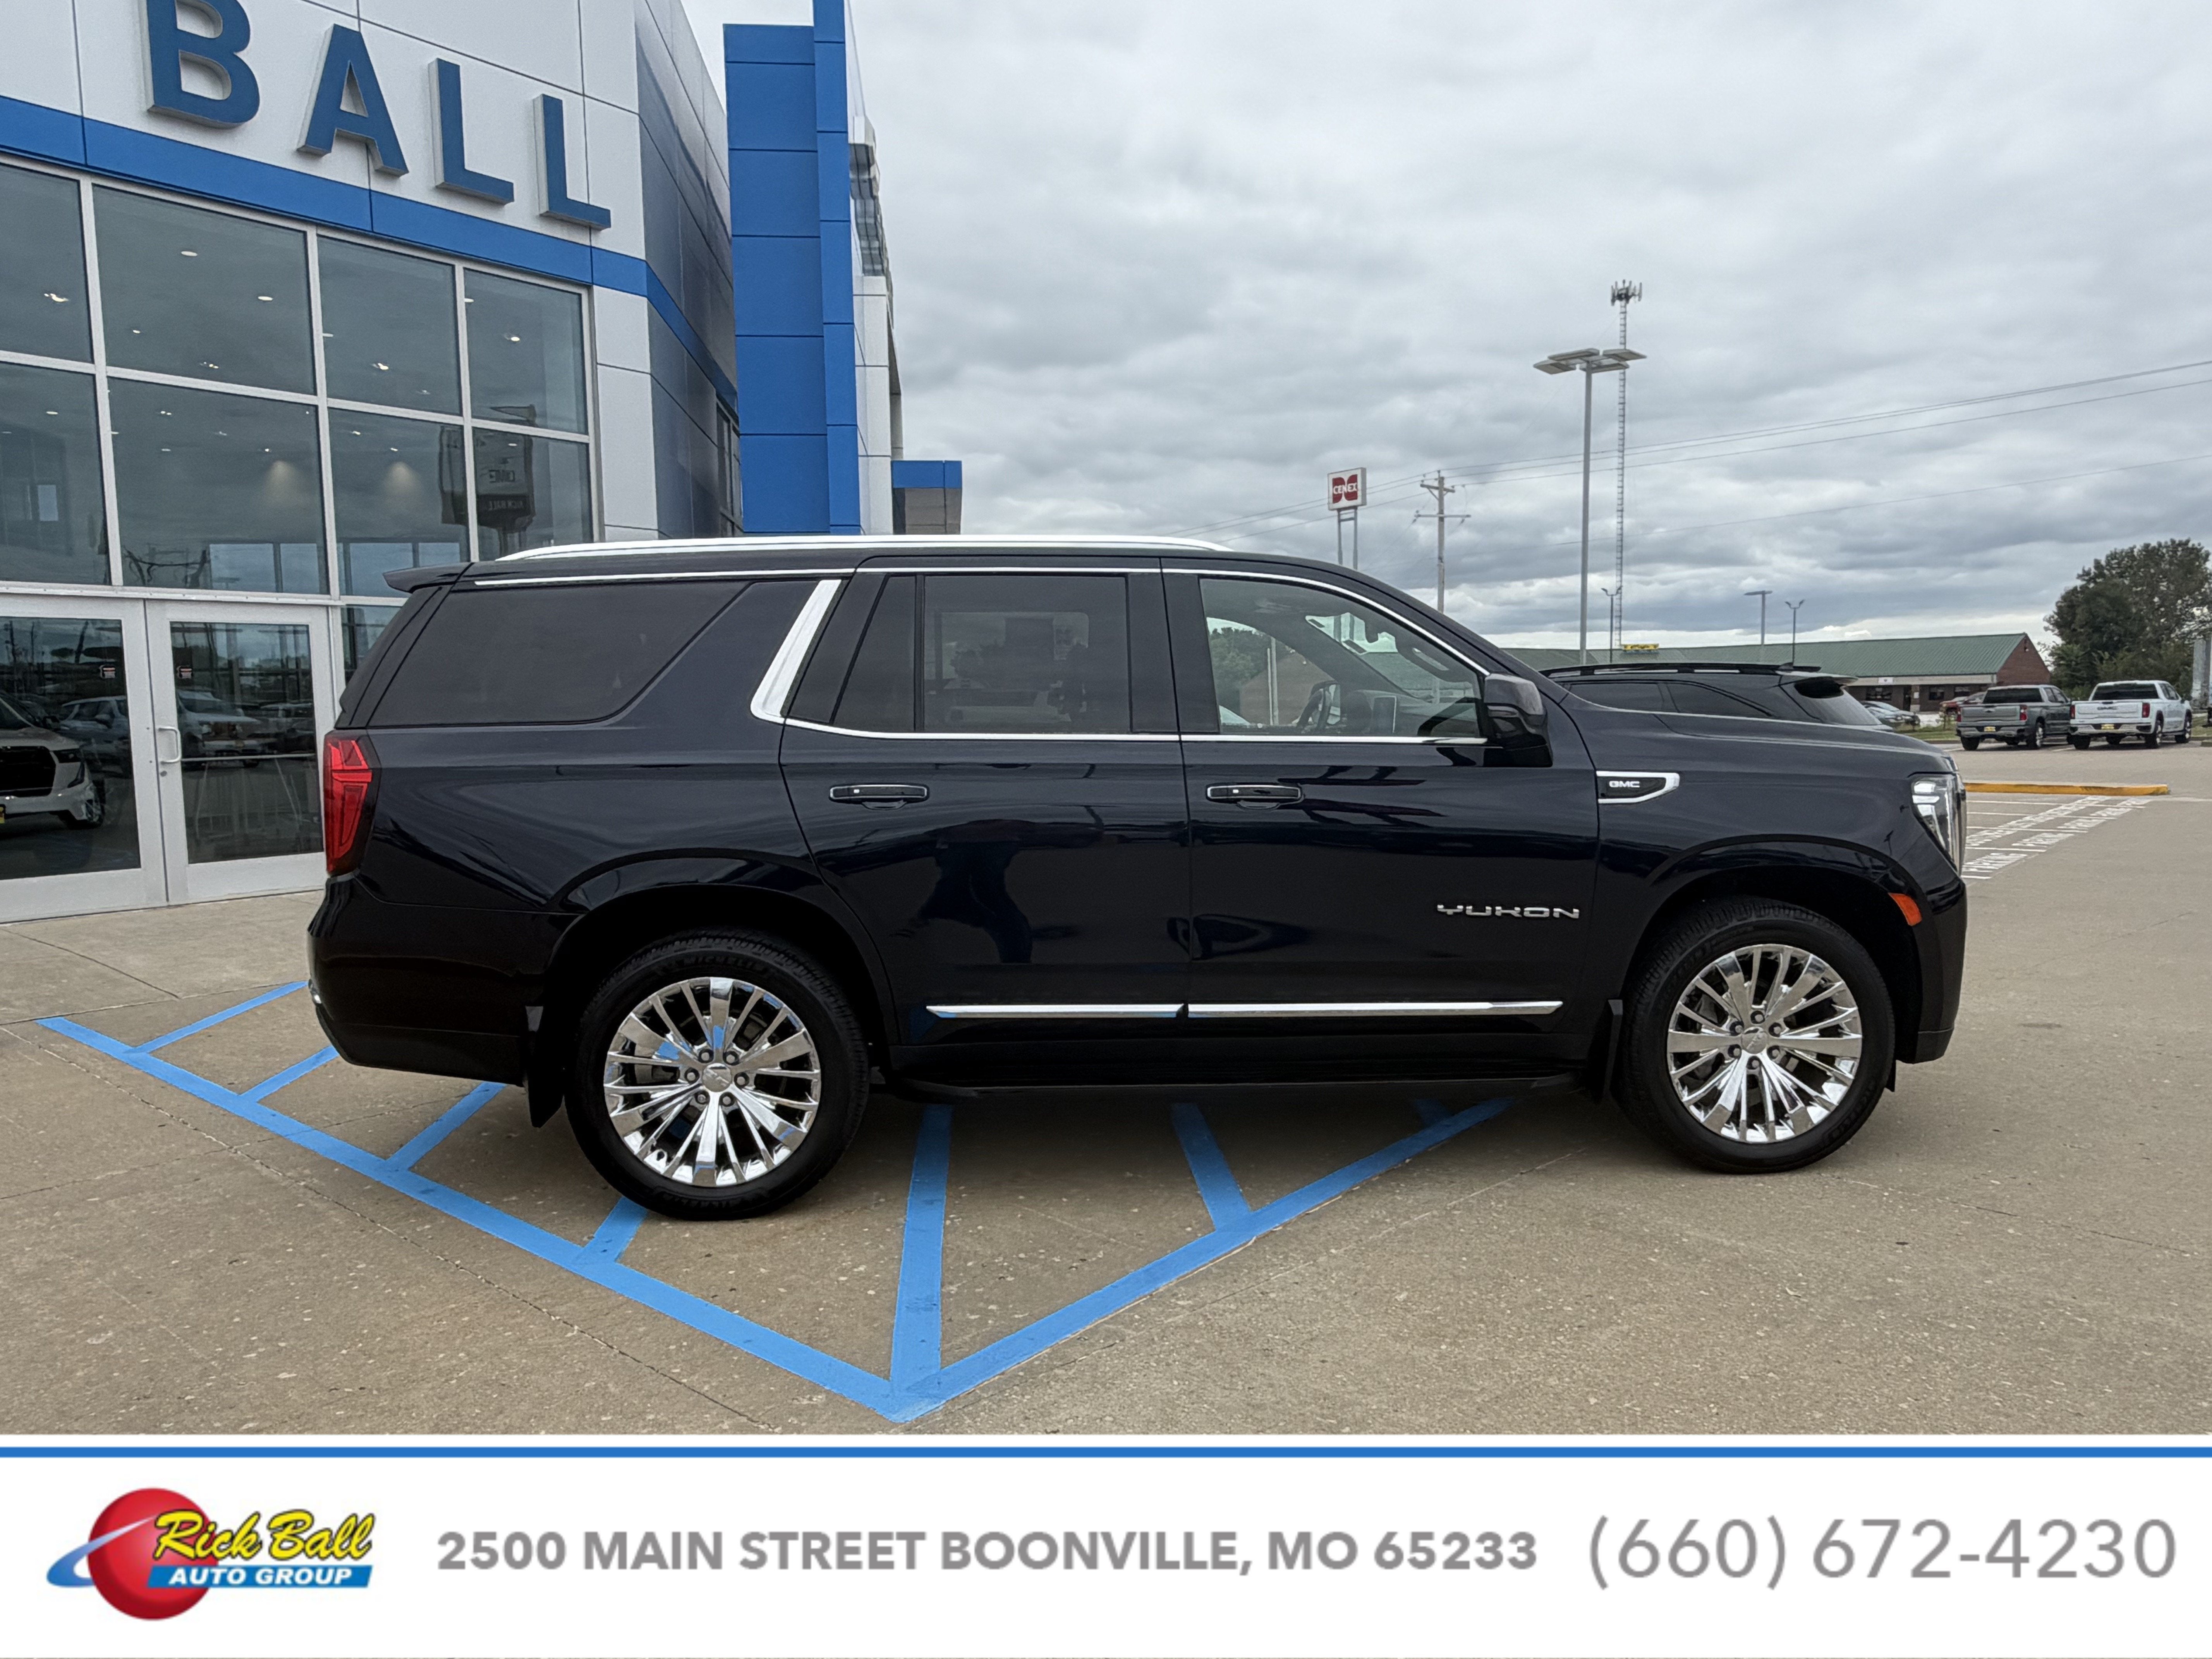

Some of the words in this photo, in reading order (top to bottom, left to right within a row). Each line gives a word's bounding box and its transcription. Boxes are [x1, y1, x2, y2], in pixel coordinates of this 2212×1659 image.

[147, 0, 611, 231] BALL
[1333, 483, 1358, 494] CENEX
[1437, 905, 1580, 919] YUKON
